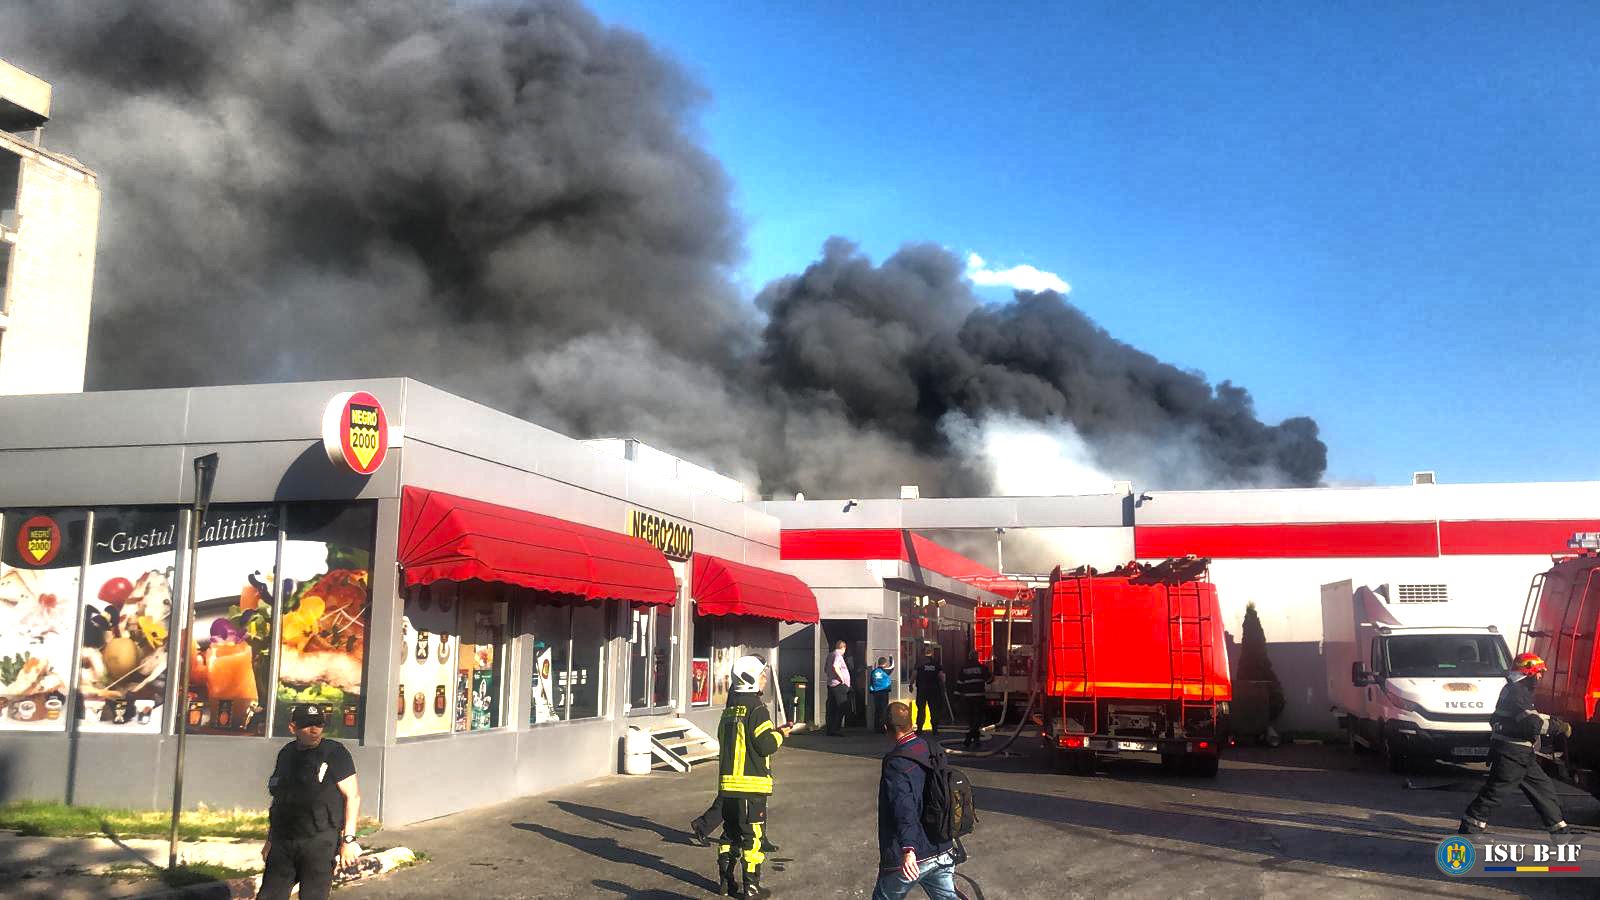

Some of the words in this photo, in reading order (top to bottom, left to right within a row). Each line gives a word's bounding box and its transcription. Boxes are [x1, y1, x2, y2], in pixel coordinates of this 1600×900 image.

[352, 432, 377, 449] 2000
[110, 524, 175, 553] Gustul
[198, 513, 266, 543] alitătii
[30, 541, 50, 551] 2000
[1445, 701, 1485, 709] IVECO
